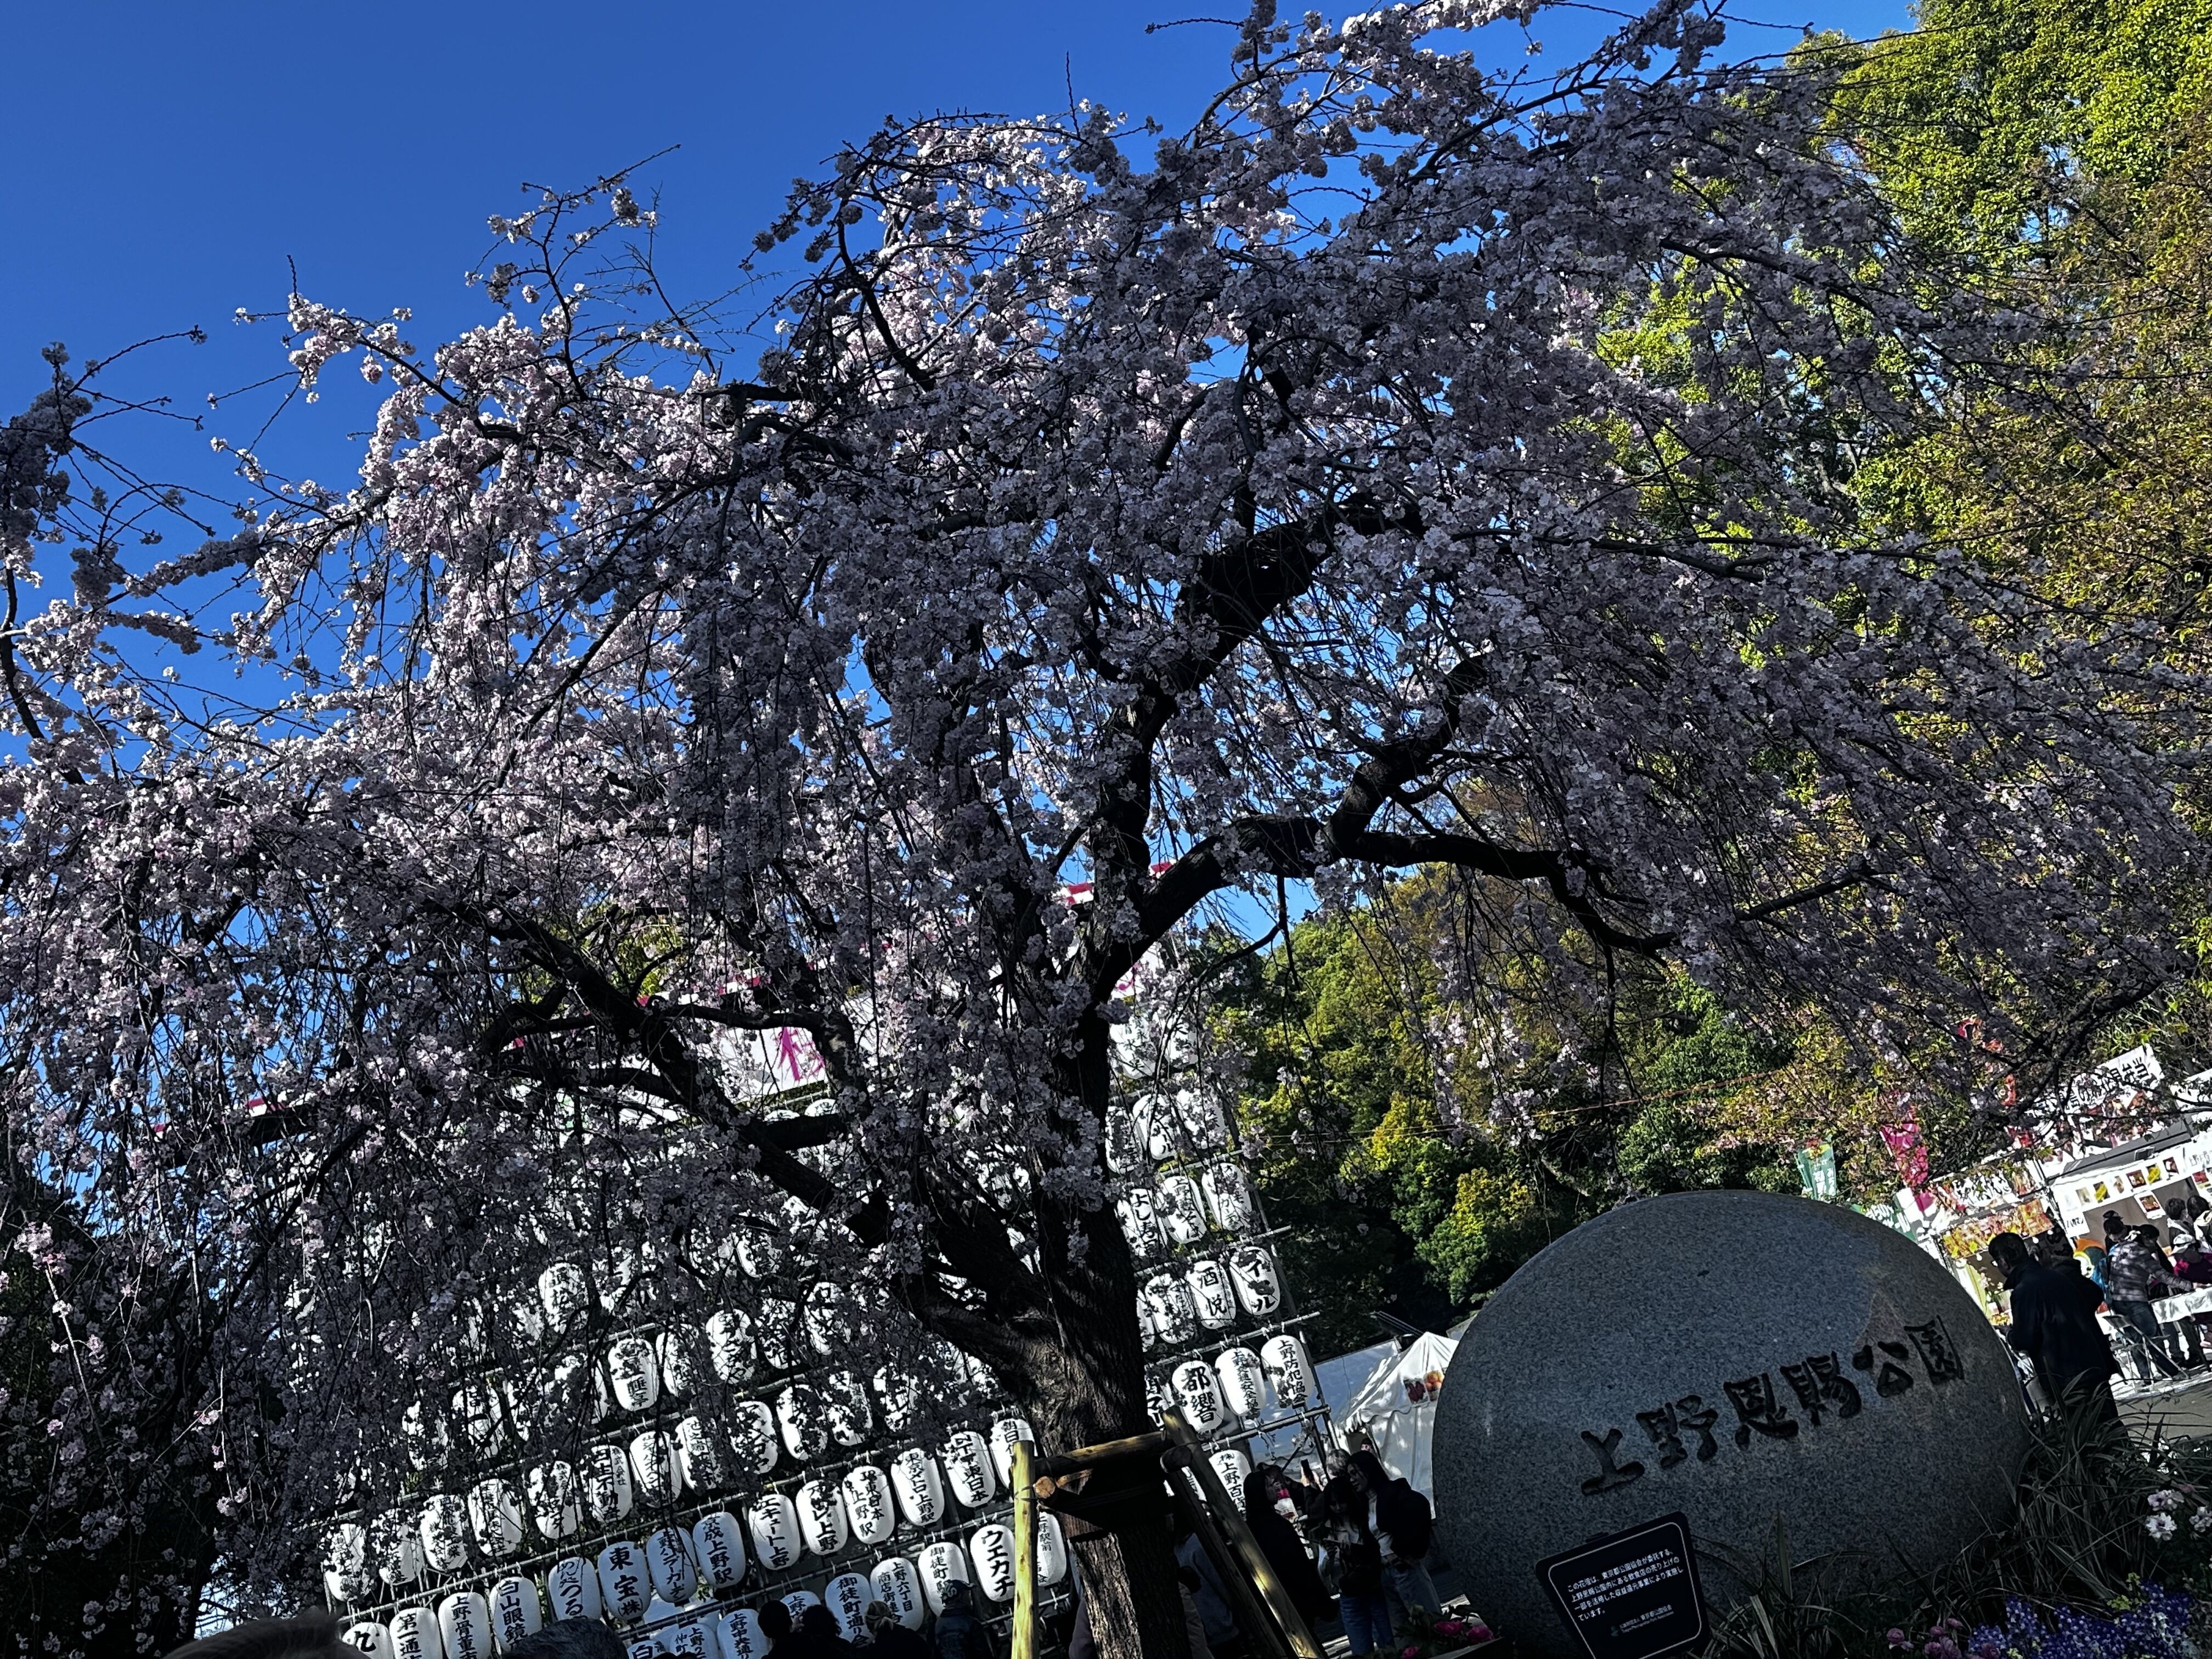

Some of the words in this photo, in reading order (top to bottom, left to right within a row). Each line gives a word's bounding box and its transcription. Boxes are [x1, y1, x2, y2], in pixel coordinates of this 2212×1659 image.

[1197, 1266, 1227, 1317] 酒悦
[1180, 1366, 1216, 1422] 都響
[1277, 1339, 1308, 1403] 上野防犯協会
[1581, 1314, 1965, 1497] 上野恩賜公園
[850, 1491, 876, 1537] 上野駅
[860, 1469, 885, 1521] JR東日本
[905, 1452, 936, 1523] 東京メトロ上野駅
[703, 1515, 735, 1585] 京成上野駅
[892, 1561, 913, 1612] 上野六丁目
